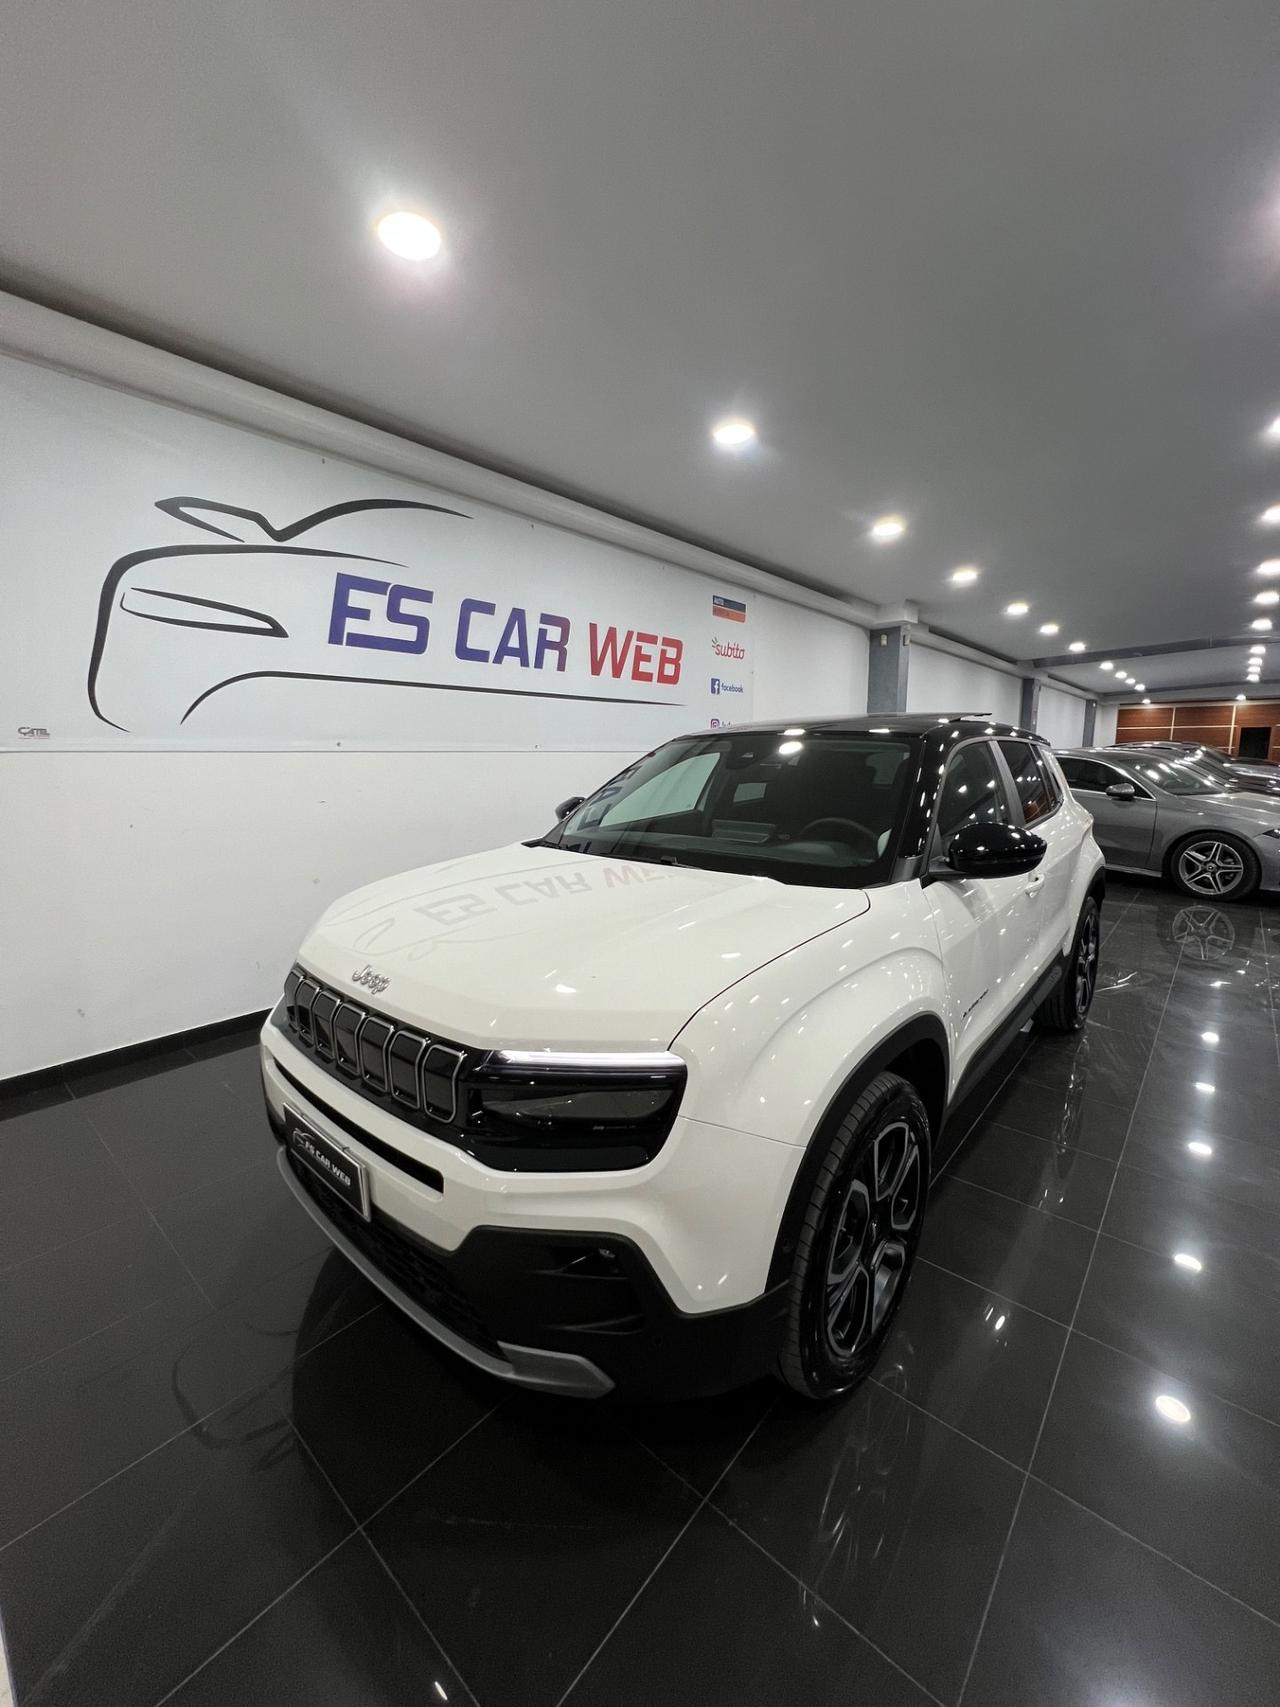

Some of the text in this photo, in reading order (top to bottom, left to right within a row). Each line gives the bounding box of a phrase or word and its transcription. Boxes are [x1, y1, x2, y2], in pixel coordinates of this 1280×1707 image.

[328, 572, 684, 685] ES CAR WEB
[715, 642, 745, 660] subito
[721, 682, 744, 693] facebook
[352, 964, 391, 995] Jeep
[315, 1150, 331, 1168] CAR
[331, 1164, 351, 1186] WEB
